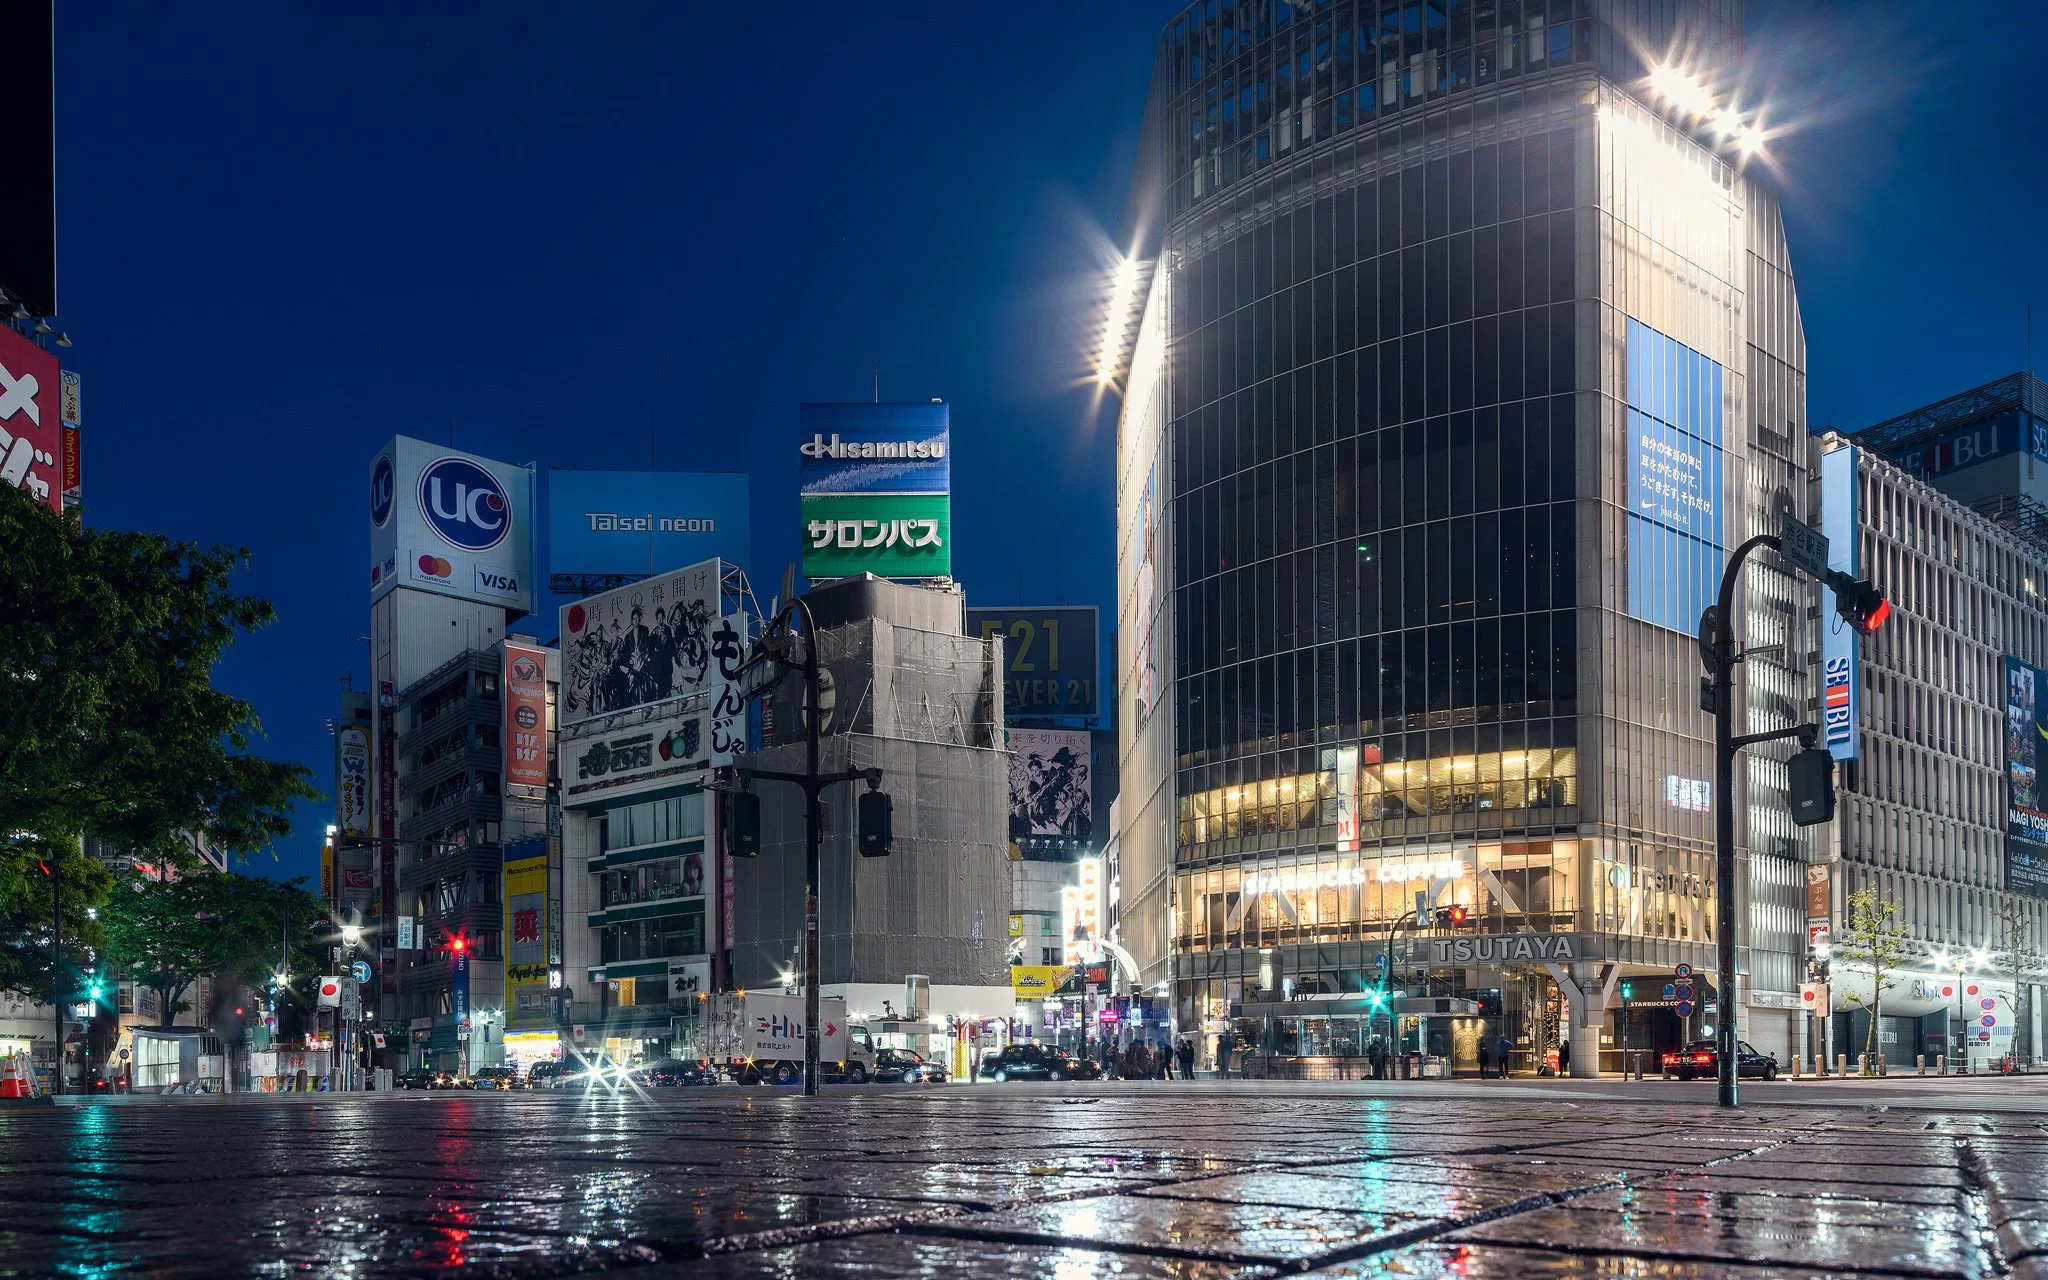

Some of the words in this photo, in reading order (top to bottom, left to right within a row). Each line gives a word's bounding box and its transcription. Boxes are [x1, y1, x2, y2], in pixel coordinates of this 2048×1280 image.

[800, 433, 945, 459] Hisamitsu
[1641, 435, 1702, 470] 自分の本当の声に
[1901, 425, 1999, 472] EIBU
[1641, 454, 1698, 489] 耳をかたむけて、
[584, 512, 653, 532] Taisei
[659, 518, 715, 533] neon
[1673, 509, 1682, 520] do
[808, 519, 943, 548] サロンパス
[1785, 521, 1825, 562] 渋谷駅前
[419, 574, 451, 585] mastercard
[478, 571, 519, 593] VISA
[711, 619, 745, 755] もんじゃ
[1003, 680, 1059, 706] EVER
[1067, 680, 1091, 706] 21
[1825, 656, 1851, 746] SEIBU
[516, 732, 537, 746] B1F
[1005, 731, 1087, 746] 来を切り拓く
[516, 747, 539, 761] B2F
[2010, 808, 2029, 826] NAGI
[507, 866, 533, 875] Matsumoto
[1643, 871, 1712, 899] TSUTAY
[1434, 936, 1574, 961] TSUTAYA
[772, 1014, 806, 1039] HIL
[757, 1042, 791, 1050] 株式会社ヒルト
